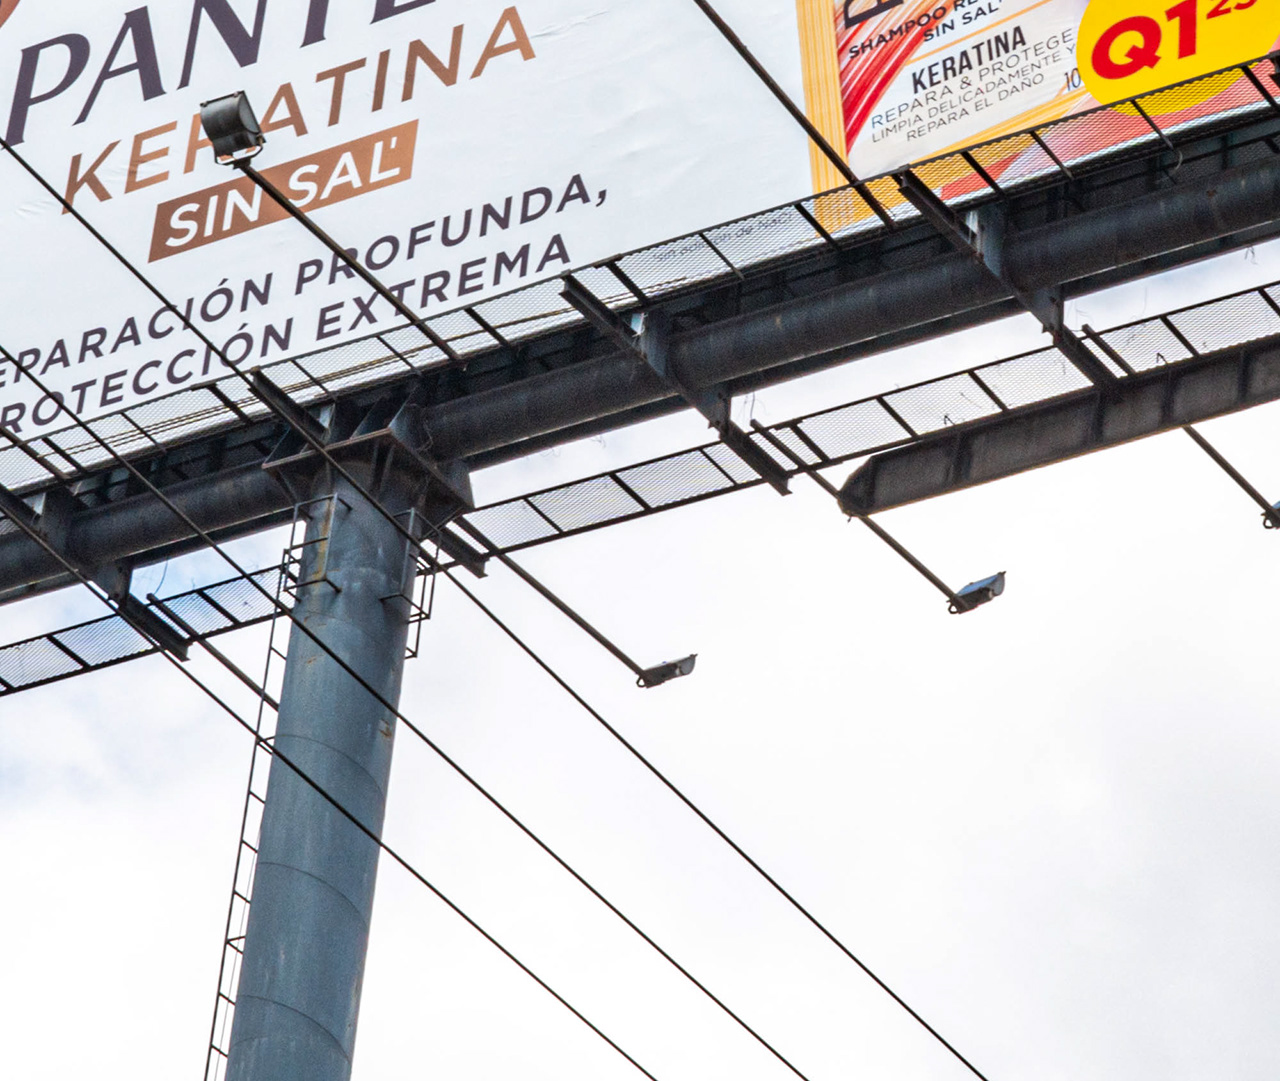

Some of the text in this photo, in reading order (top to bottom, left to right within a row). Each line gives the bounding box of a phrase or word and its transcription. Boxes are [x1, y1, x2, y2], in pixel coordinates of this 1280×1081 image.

[849, 6, 947, 59] SHAMPOO
[912, 25, 1027, 94] KERATINA
[923, 19, 955, 42] SIN
[871, 28, 1074, 128] REPARA & PROTEGE
[872, 114, 922, 143] LIMPIA
[929, 51, 1062, 116] DELICADAMENTE
[906, 72, 1045, 142] REPARA EL DAÑO
[165, 184, 263, 247] SIN
[295, 173, 607, 296] PROFUNDA,
[316, 233, 571, 341] EXTREMA
